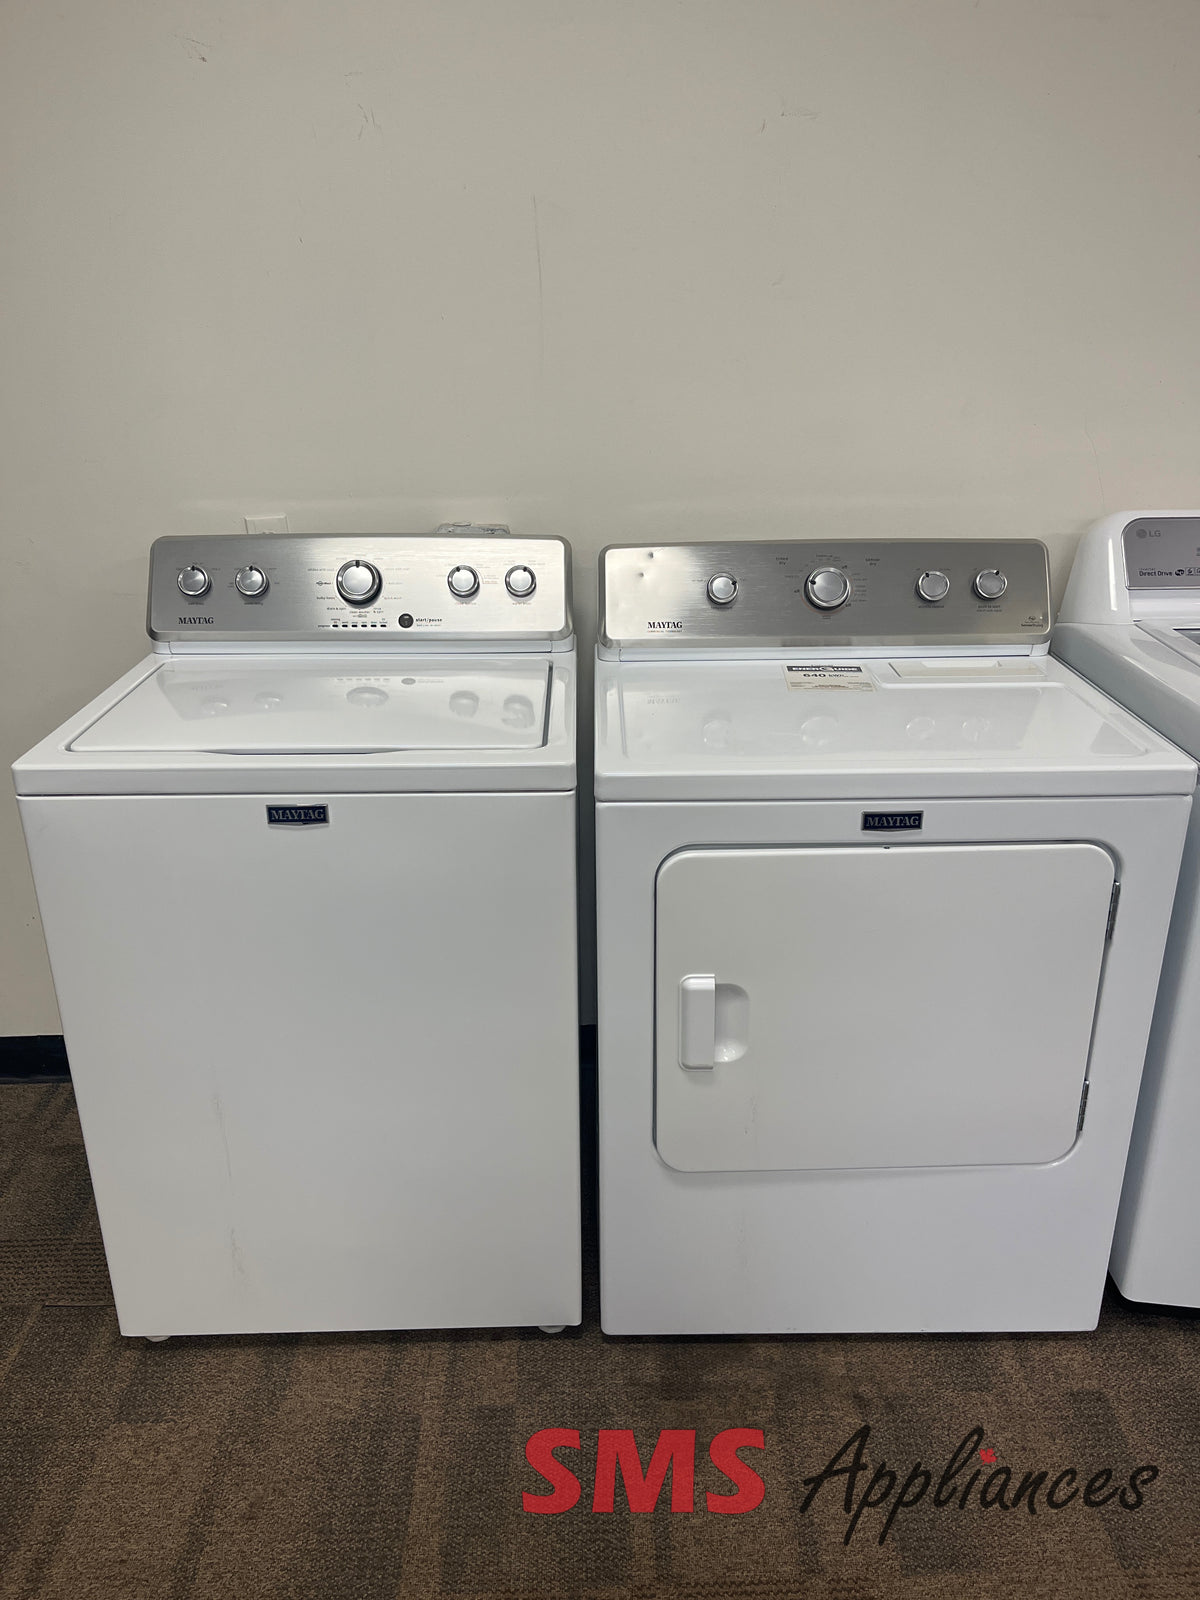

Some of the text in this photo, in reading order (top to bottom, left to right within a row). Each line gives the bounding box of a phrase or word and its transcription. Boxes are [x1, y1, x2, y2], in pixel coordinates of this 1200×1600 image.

[1148, 529, 1161, 538] LG
[178, 616, 214, 625] MAYTAG
[647, 621, 683, 629] MAYTAG
[270, 809, 325, 820] MAYTAG
[866, 815, 920, 827] MAYTAG
